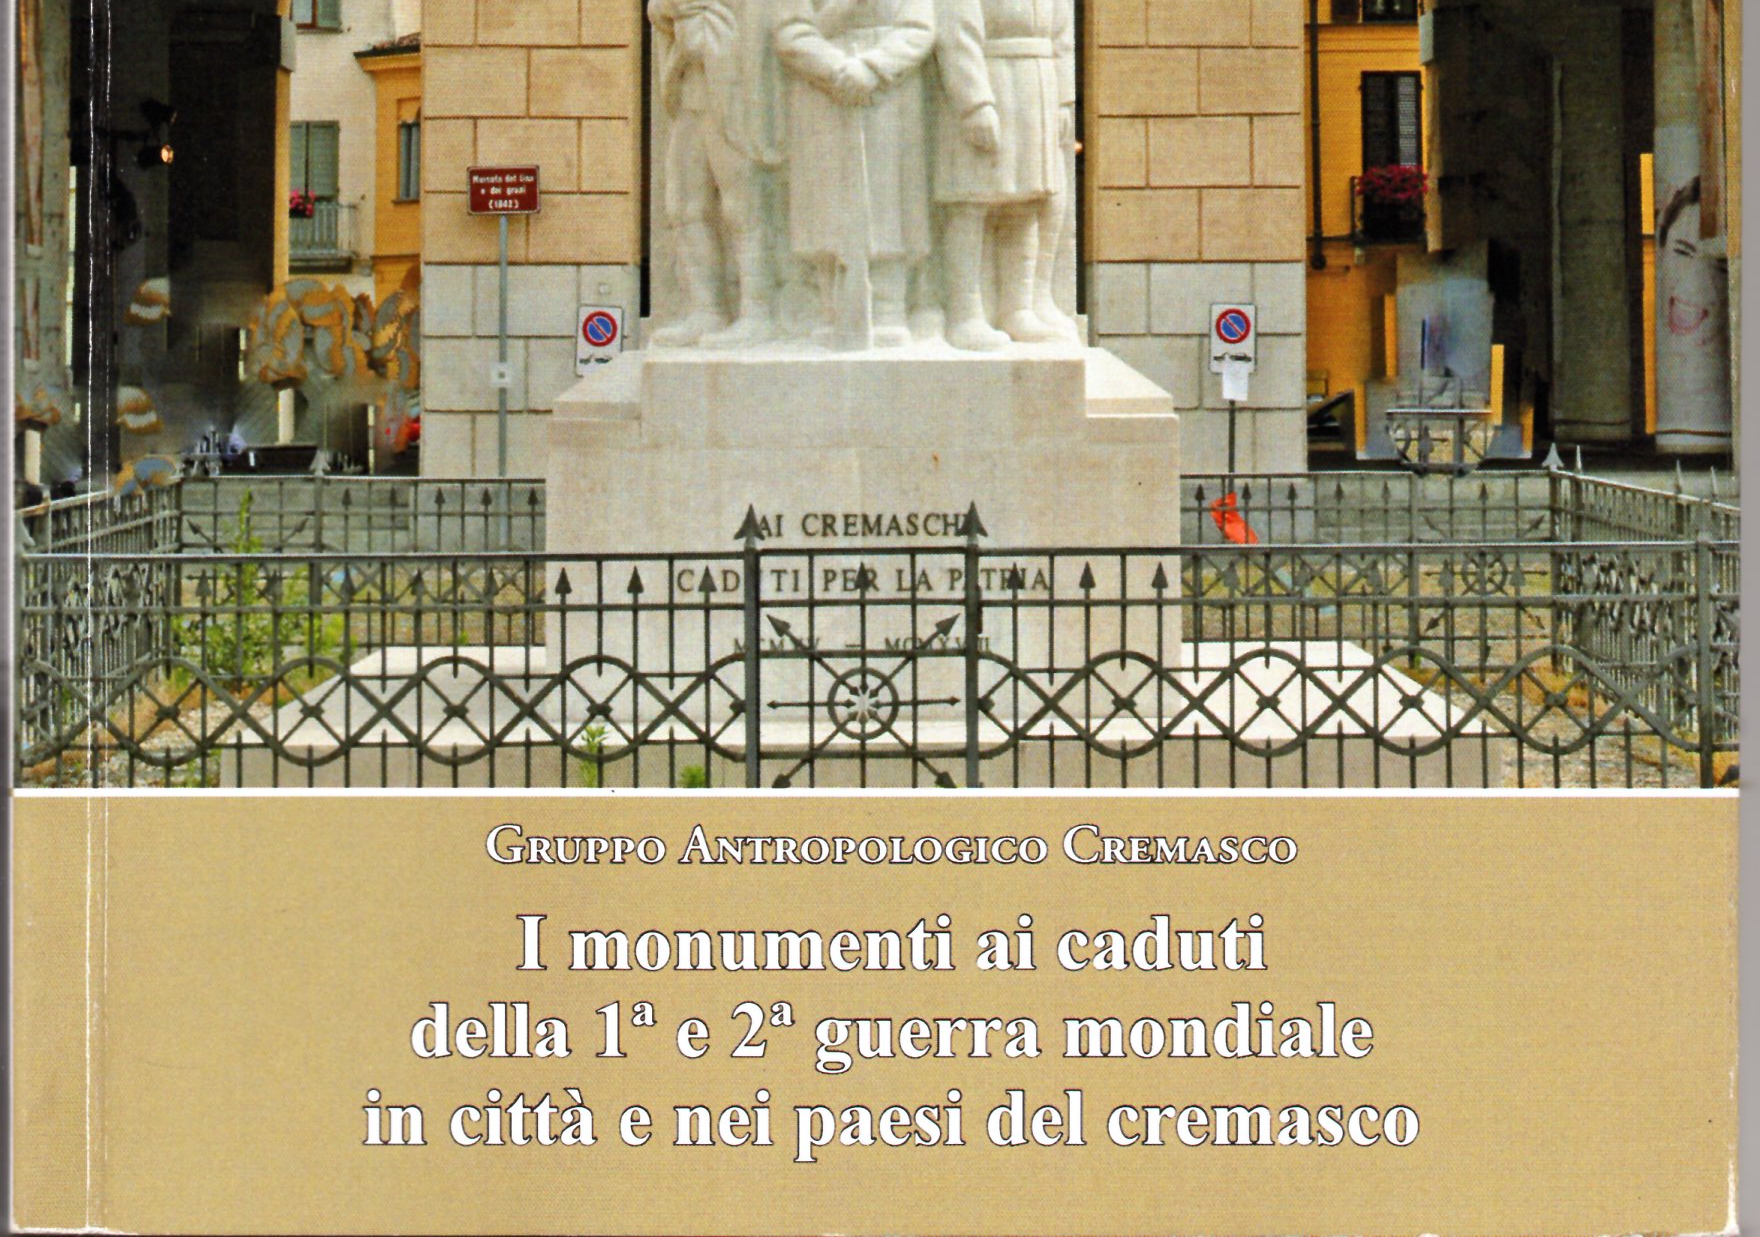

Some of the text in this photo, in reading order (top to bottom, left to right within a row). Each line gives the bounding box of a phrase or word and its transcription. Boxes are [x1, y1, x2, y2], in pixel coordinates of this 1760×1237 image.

[801, 513, 967, 537] CREMASCH
[677, 569, 799, 593] CDTI
[896, 568, 933, 592] LA
[516, 913, 1268, 972] I monumenti ai caduti
[411, 1001, 573, 1059] della
[676, 1017, 710, 1058] e
[814, 1016, 1043, 1075] guerra
[1063, 1000, 1375, 1059] mondiale
[362, 1087, 1420, 1163] in città e nei paesi del cremasco
